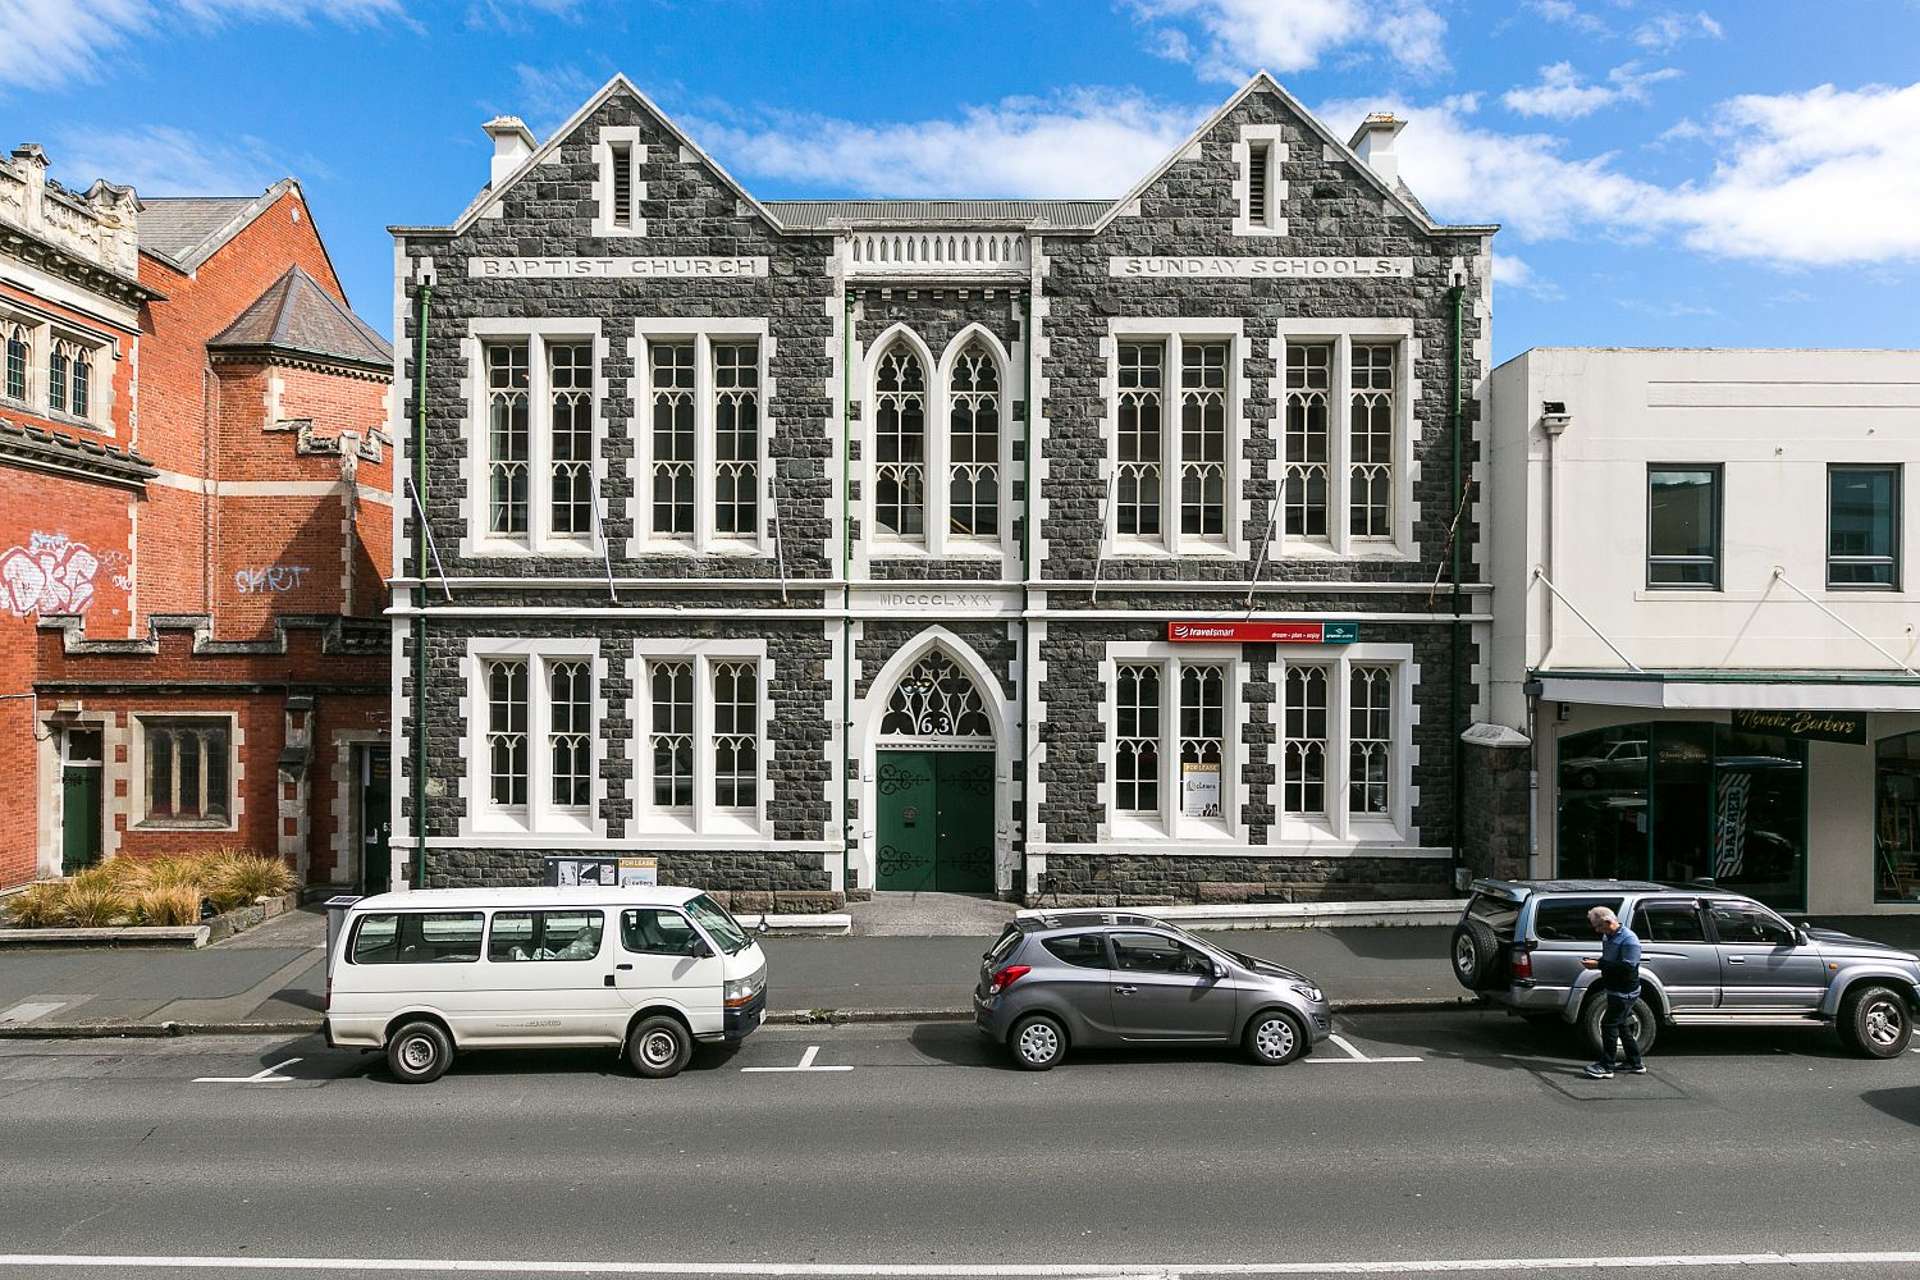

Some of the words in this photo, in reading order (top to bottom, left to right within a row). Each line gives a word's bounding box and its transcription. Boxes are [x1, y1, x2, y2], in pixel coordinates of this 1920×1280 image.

[481, 259, 614, 275] BAPTIST
[631, 259, 756, 275] CHURCH
[1124, 259, 1241, 275] SUNDAY
[879, 593, 993, 607] MDCCCLXXX
[1189, 627, 1235, 638] travelsmart
[921, 717, 950, 733] 63
